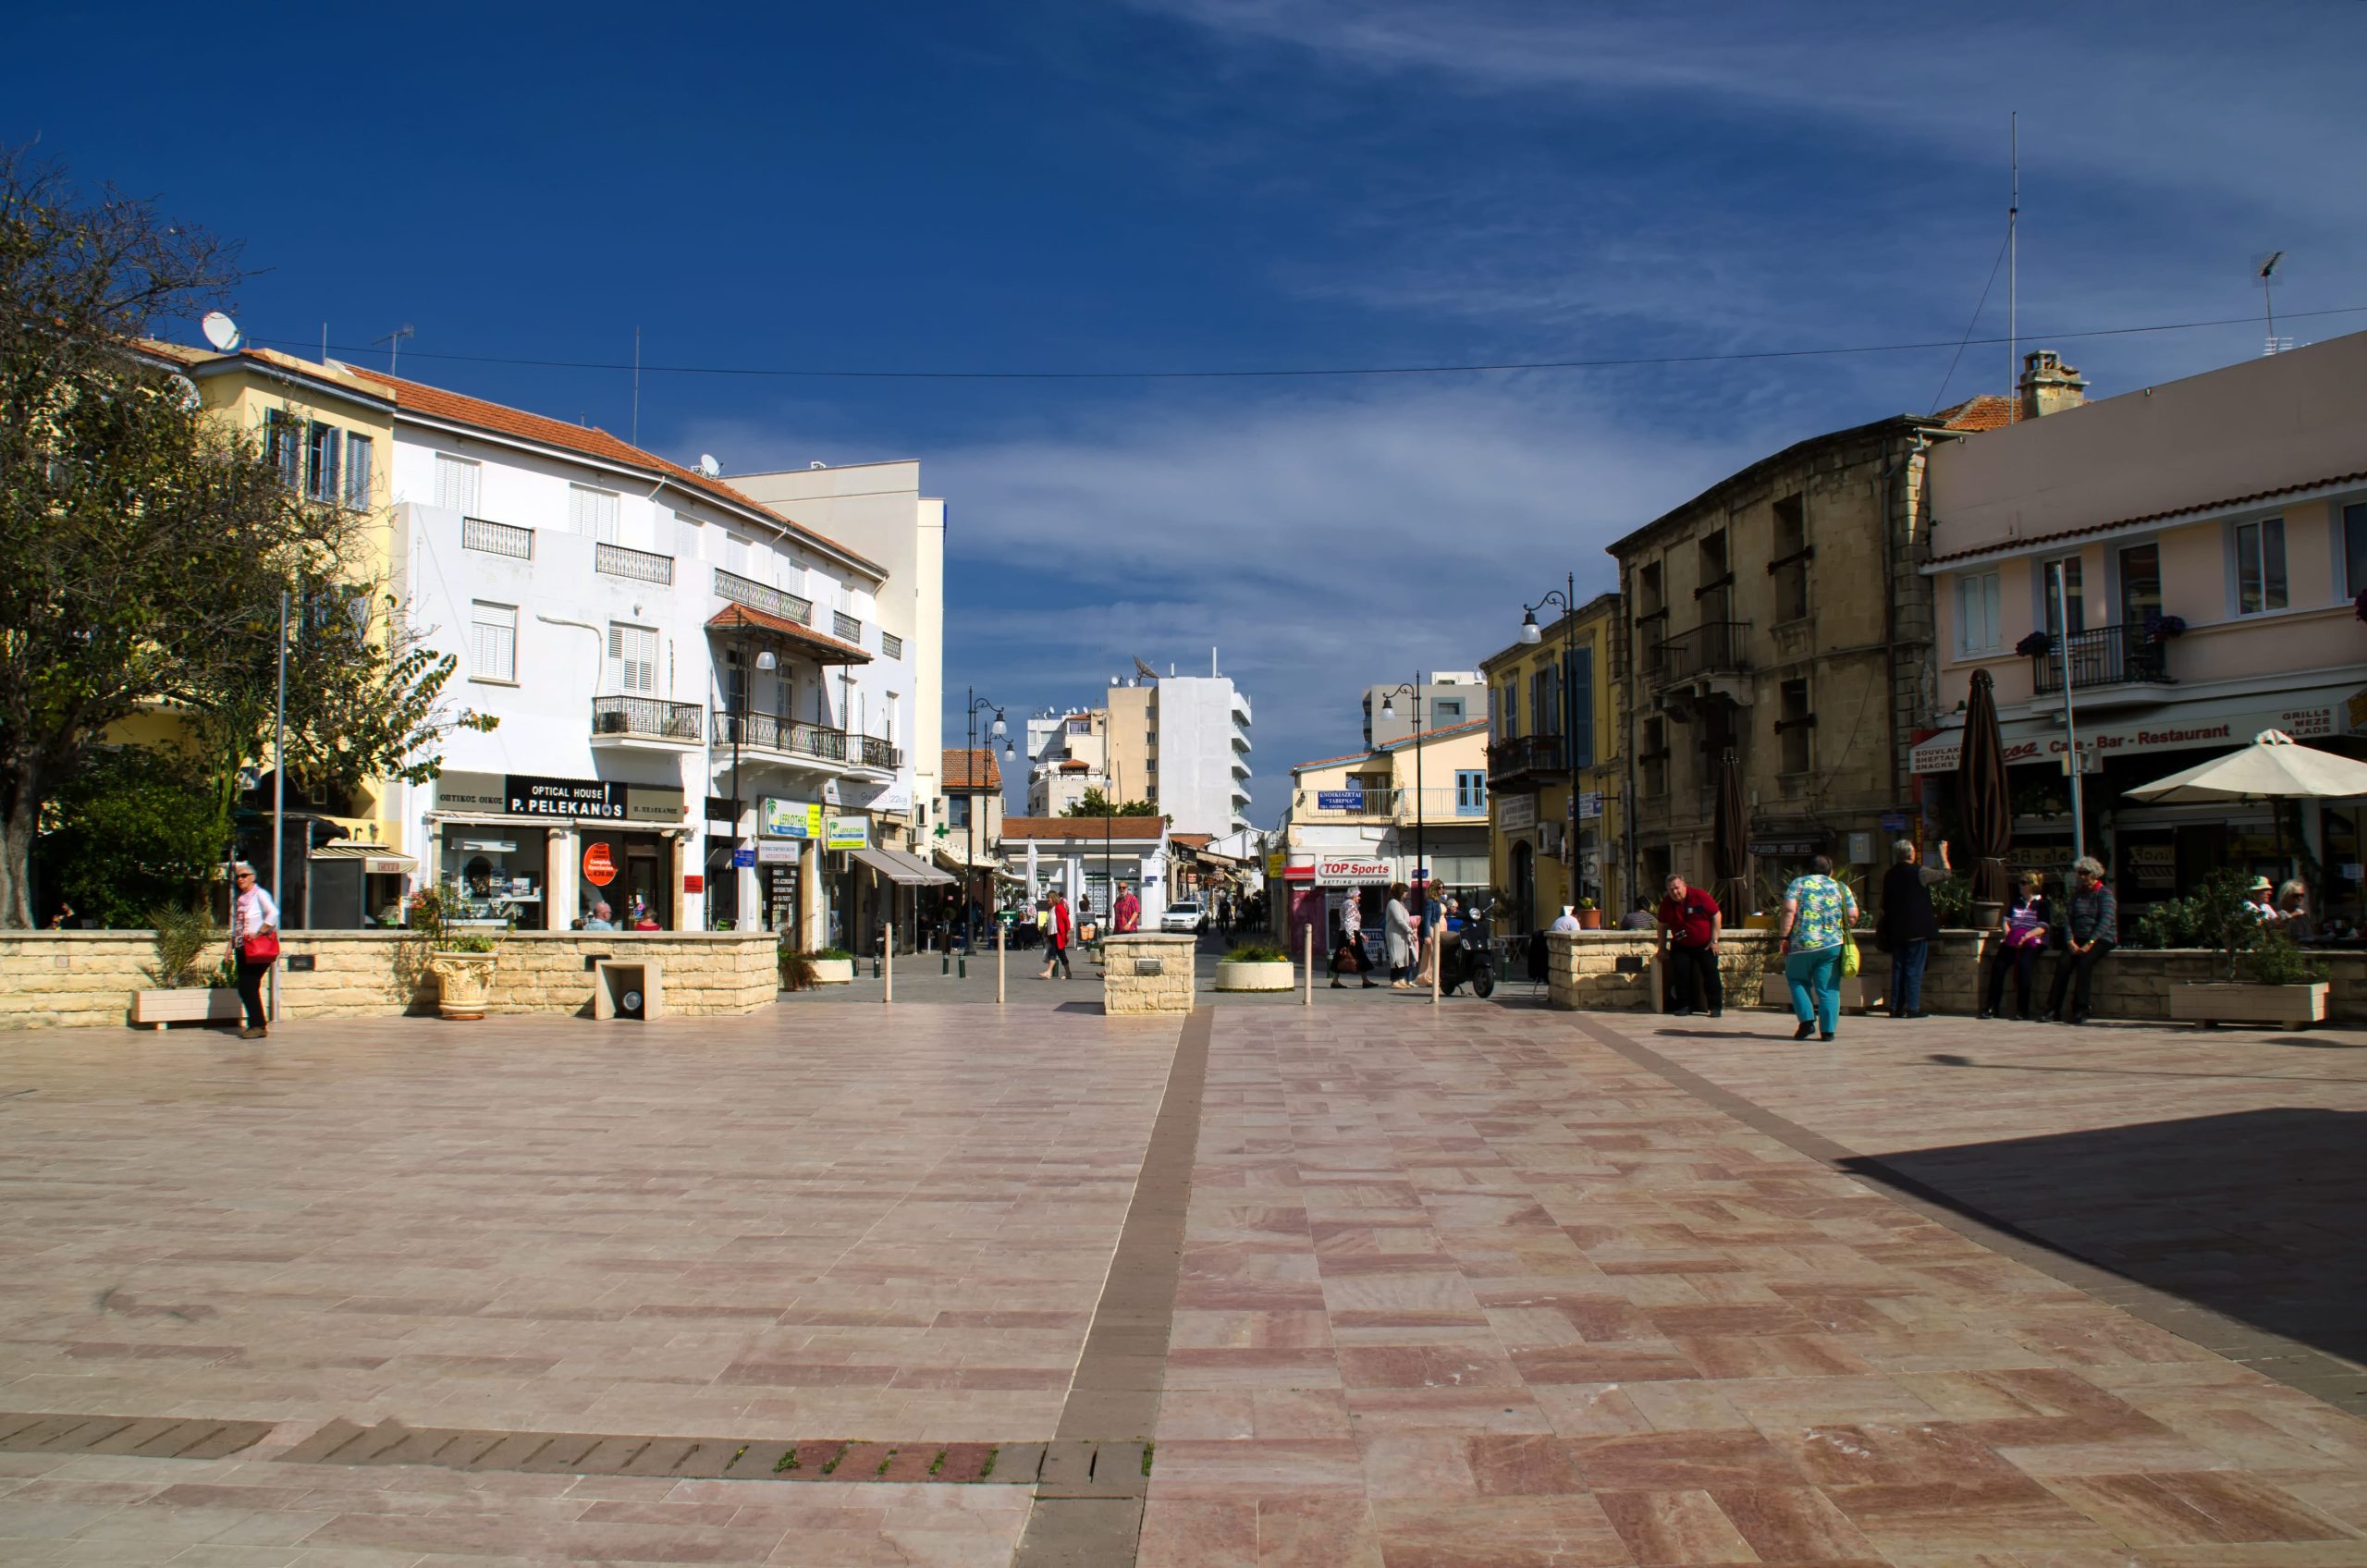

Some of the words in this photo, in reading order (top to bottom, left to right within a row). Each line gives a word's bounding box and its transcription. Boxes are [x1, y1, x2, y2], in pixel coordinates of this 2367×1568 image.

[2282, 709, 2330, 720] GRILLS
[2294, 717, 2330, 728] MEZE
[2097, 736, 2125, 750] Bar
[2138, 724, 2230, 745] Restaurant
[1915, 747, 1960, 757] SOUVLAK
[1915, 762, 1954, 770] SNACKS
[532, 786, 570, 797] OPTICAL
[573, 789, 604, 800] HOUSE
[439, 794, 476, 803] ΟΠΤΙΚΟΣ
[478, 796, 504, 804] ΟΙΚΟΣ
[511, 798, 524, 812] P.
[528, 799, 623, 817] PELEKANOS
[1324, 863, 1349, 874] TOP
[1350, 864, 1390, 876] Sports
